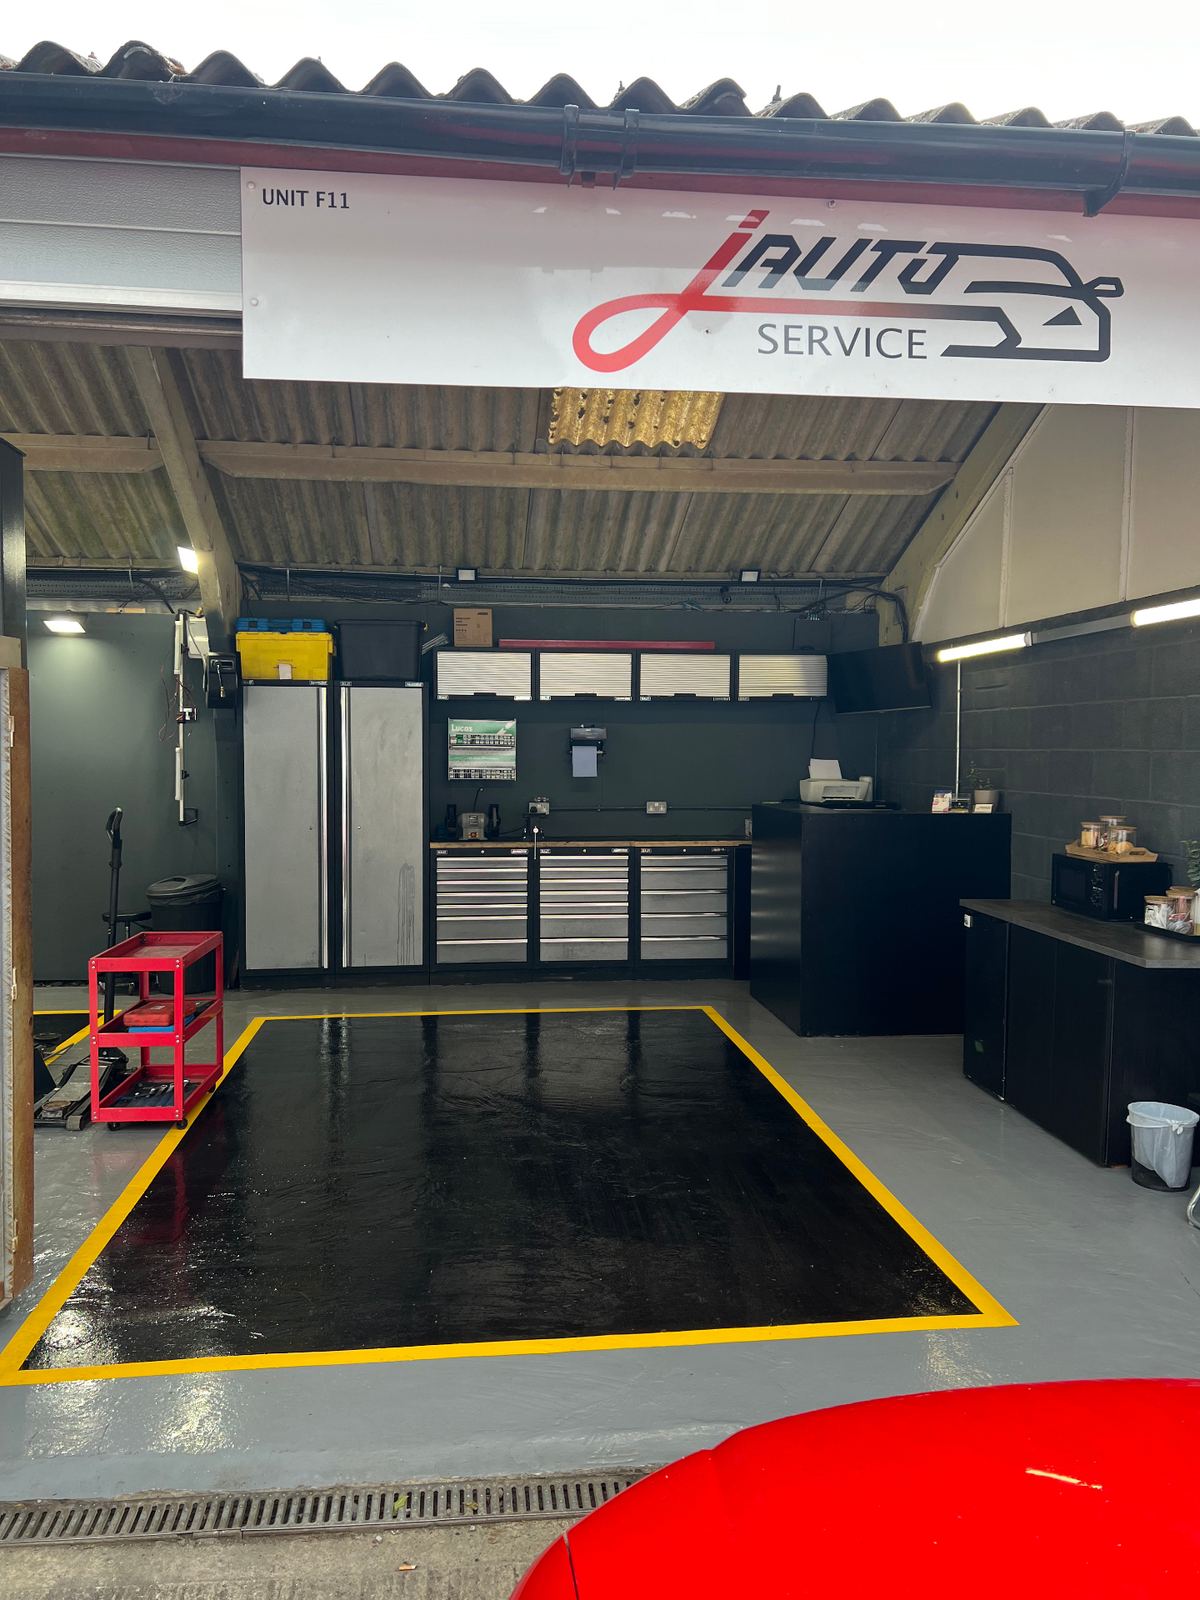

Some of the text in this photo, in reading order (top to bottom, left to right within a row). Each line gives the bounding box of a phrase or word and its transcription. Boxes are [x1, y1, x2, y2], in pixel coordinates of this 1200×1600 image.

[262, 188, 350, 209] UNIT F11
[757, 323, 928, 360] SERVICE
